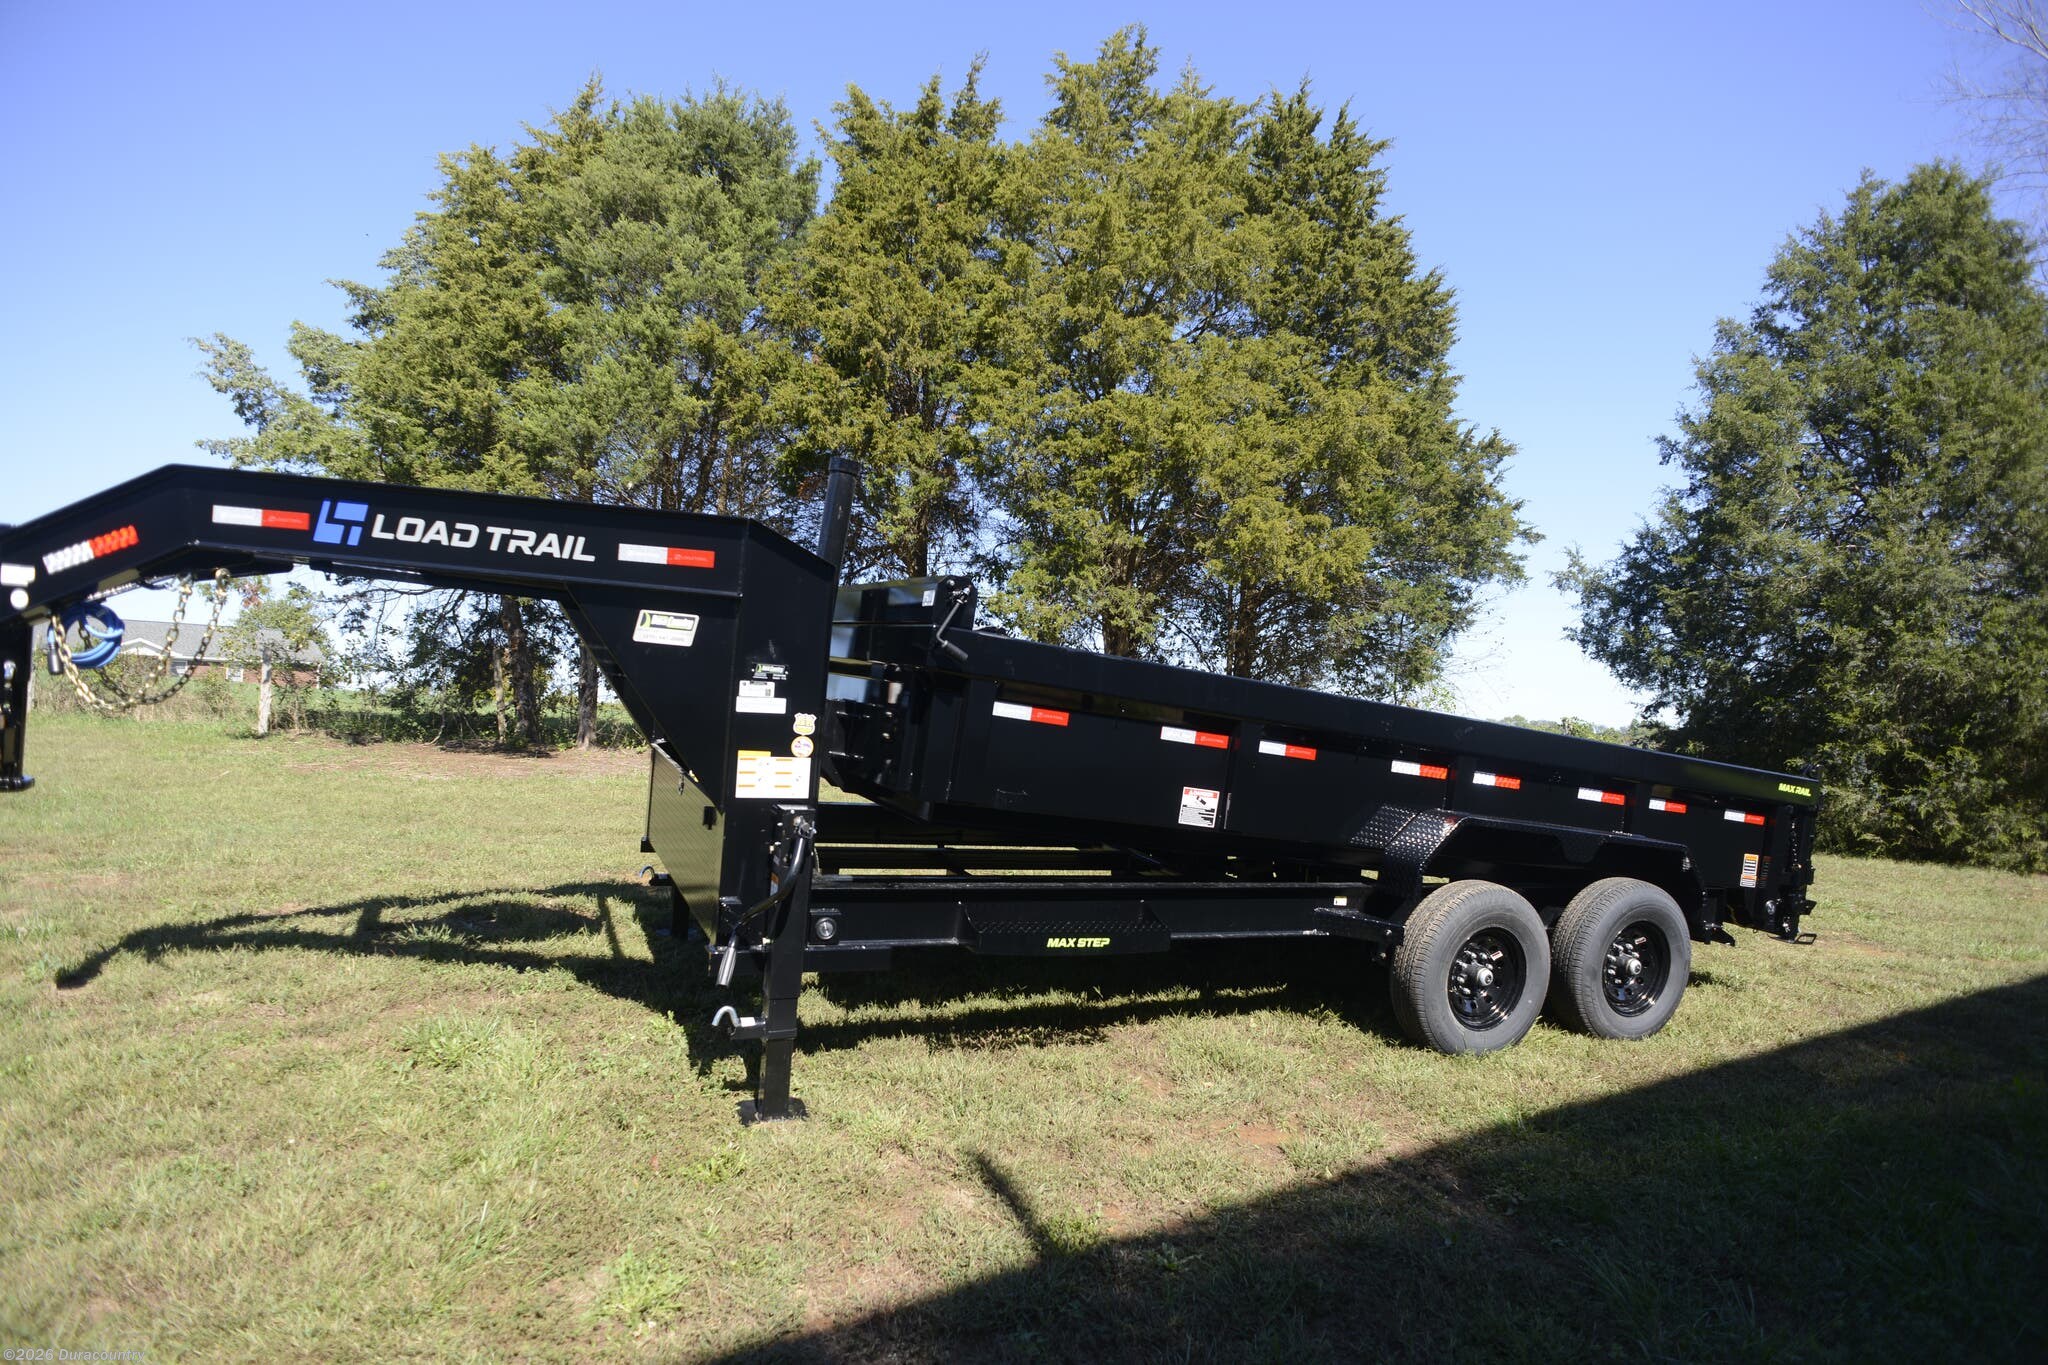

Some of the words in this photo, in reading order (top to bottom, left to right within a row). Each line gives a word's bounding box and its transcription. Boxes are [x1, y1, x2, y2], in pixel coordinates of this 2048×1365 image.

[371, 513, 480, 549] LOAD
[486, 526, 596, 562] TRAIL
[1046, 937, 1077, 948] MAX
[1076, 937, 1111, 948] STEP
